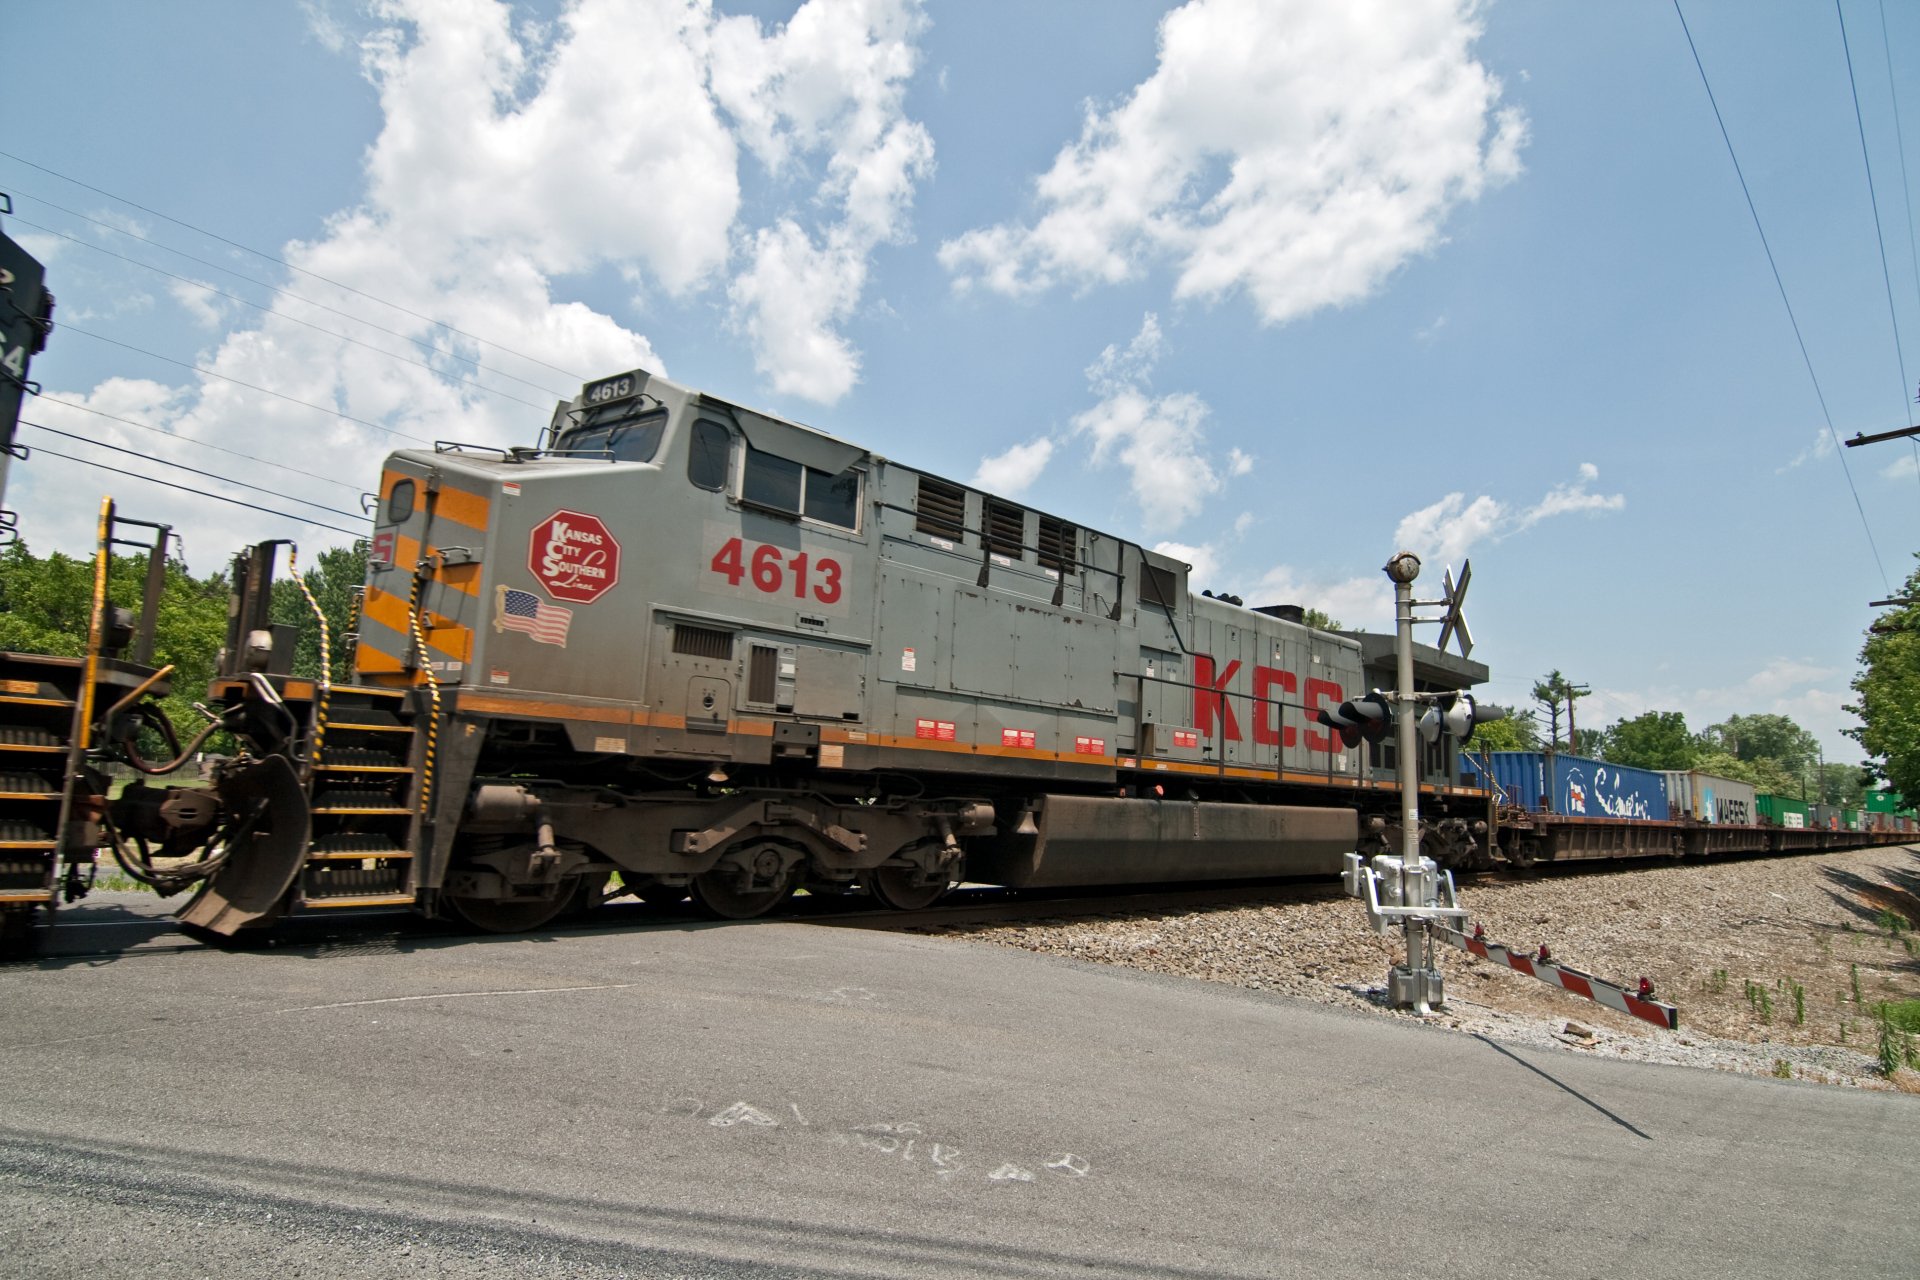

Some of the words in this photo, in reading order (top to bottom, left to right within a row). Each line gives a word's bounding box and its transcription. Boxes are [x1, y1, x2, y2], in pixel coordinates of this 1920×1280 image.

[591, 378, 630, 402] 4613
[711, 537, 842, 604] 4613
[1194, 652, 1343, 753] KCS
[465, 724, 476, 737] F
